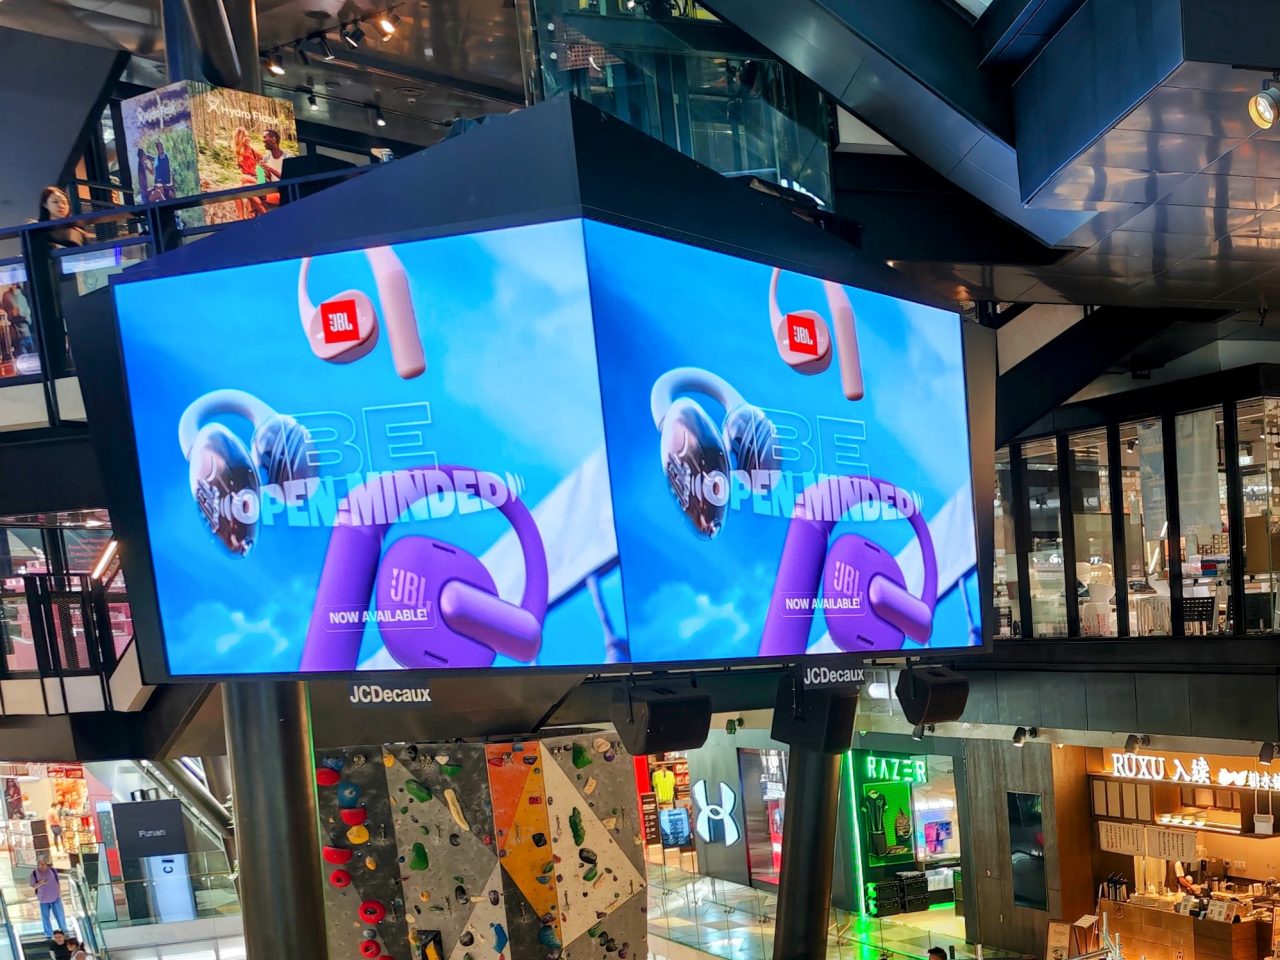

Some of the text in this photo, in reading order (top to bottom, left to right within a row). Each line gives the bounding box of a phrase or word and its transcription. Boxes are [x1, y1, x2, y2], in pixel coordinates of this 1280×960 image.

[221, 106, 280, 125] Hydro Flask
[328, 312, 353, 332] JBL
[792, 325, 814, 346] JBL
[282, 401, 440, 482] BE
[751, 407, 870, 477] BE
[391, 568, 430, 611] JBL
[833, 561, 863, 599] JBL
[785, 597, 861, 610] NOW AVAILABLE!
[329, 608, 428, 624] NOW AVAILABLE!
[803, 667, 865, 686] JCDecaux
[349, 684, 432, 704] JCDecaux
[866, 755, 927, 783] RAZER
[138, 829, 167, 838] Funan
